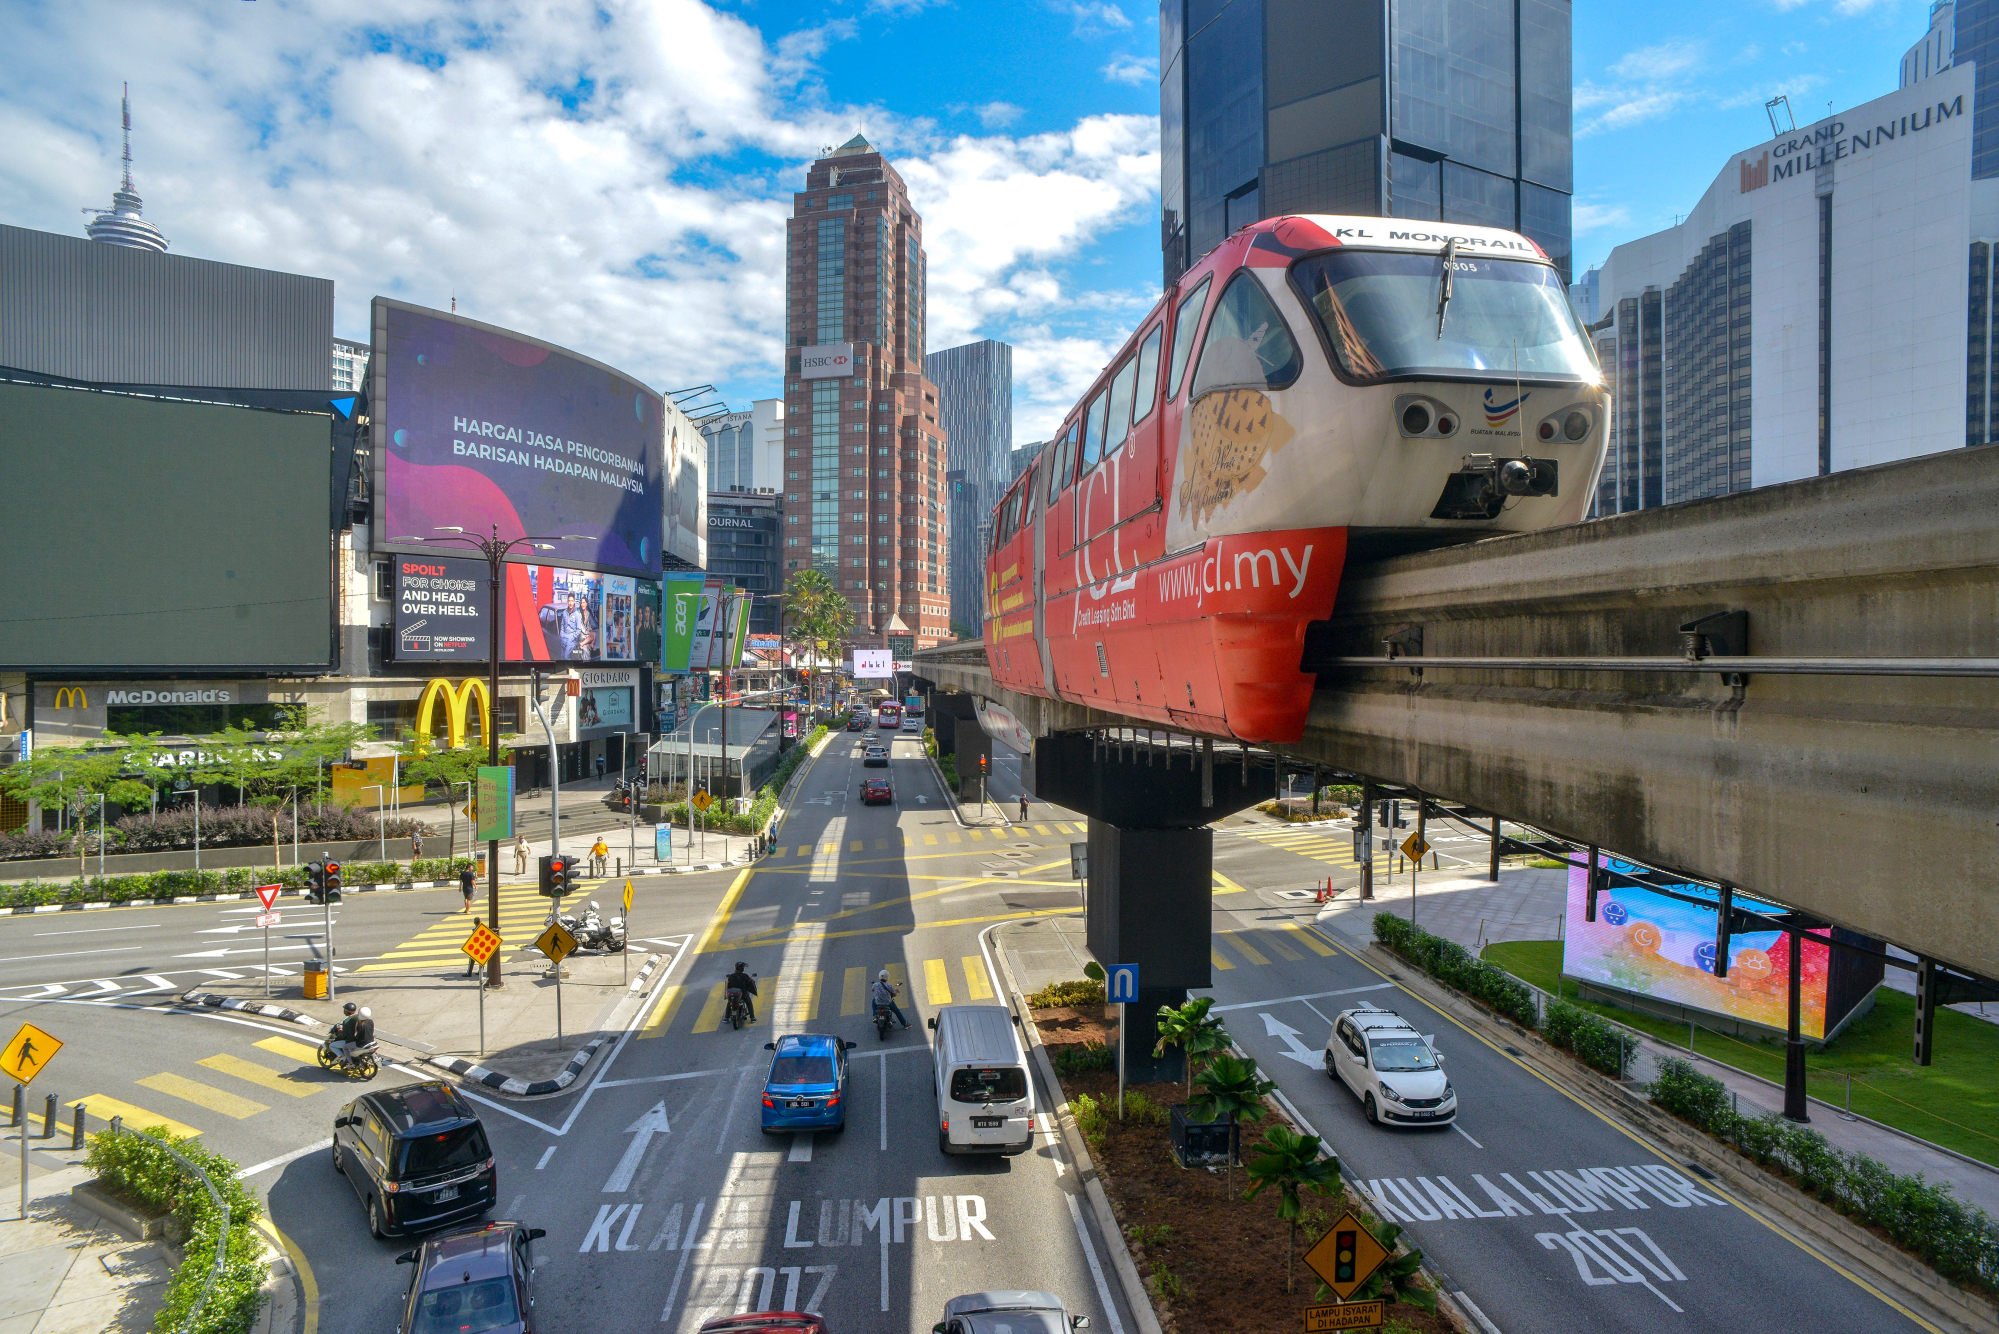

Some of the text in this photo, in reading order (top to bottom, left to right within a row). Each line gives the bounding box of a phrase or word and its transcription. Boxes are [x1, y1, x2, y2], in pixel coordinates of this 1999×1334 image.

[1772, 95, 1964, 182] MILLENNIUM
[1773, 122, 1845, 158] GRAND
[1336, 228, 1533, 252] KL MONORAIL
[1443, 261, 1478, 273] 0305
[804, 357, 832, 368] HSBC
[701, 413, 753, 426] HOTEL ISTANA
[454, 415, 644, 477] HARGAI JASA PENGORBANAN
[453, 439, 644, 496] BARISAN HADAPAN MALAYSIA
[709, 517, 754, 528] OURNAL
[1073, 446, 1140, 640] JCL
[402, 563, 446, 576] SPOILT
[1158, 541, 1314, 608] www.jcl.my
[402, 577, 476, 592] FOR CHOICE
[402, 590, 466, 603] AND HEAD
[402, 603, 479, 617] OVER HEELS.
[675, 594, 687, 637] acer
[1078, 608, 1091, 627] Credit
[1091, 604, 1111, 628] Leasing
[582, 671, 631, 685] GIORDANO
[107, 689, 231, 705] McDonald's
[123, 748, 284, 768] SARBUKS
[1354, 1164, 1731, 1223] KUALA LUMPUR
[783, 1194, 996, 1249] LUMPUR
[1534, 1226, 1689, 1287] 2017
[1309, 1305, 1378, 1319] LAMPU ISYARAT
[1318, 1315, 1371, 1328] DI HADAPAN
